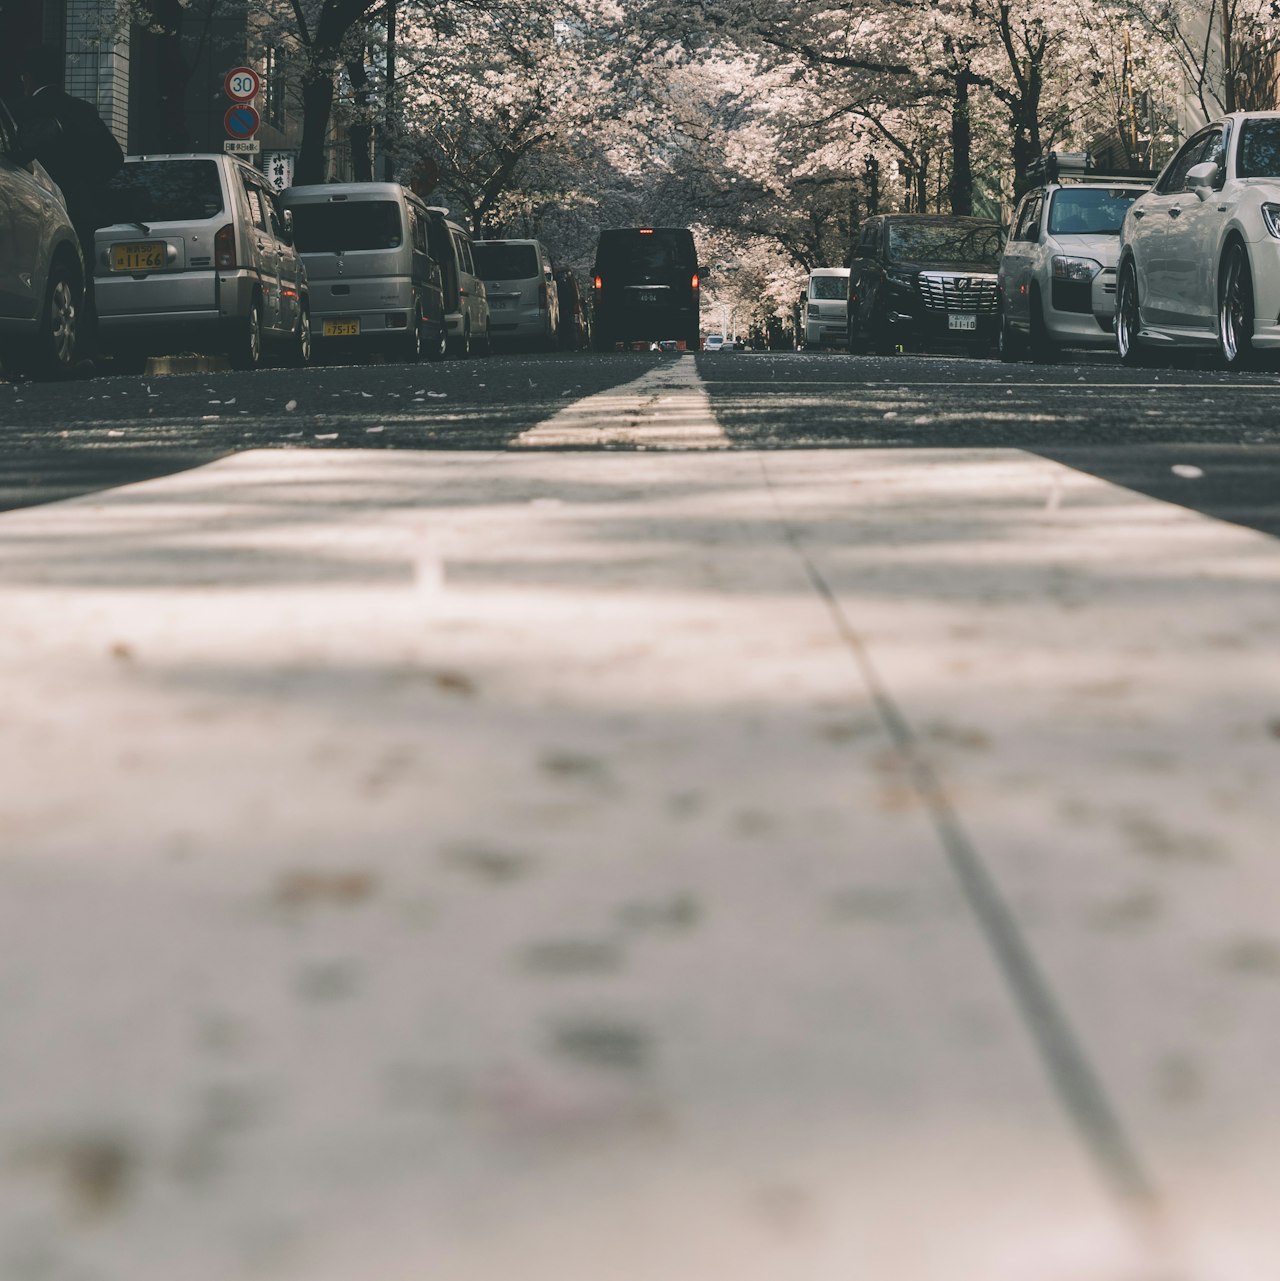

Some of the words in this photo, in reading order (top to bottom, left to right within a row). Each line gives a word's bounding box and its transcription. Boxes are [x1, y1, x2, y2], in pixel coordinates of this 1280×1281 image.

[233, 77, 252, 92] 30
[127, 253, 161, 267] 11-66
[332, 325, 356, 334] 75-15
